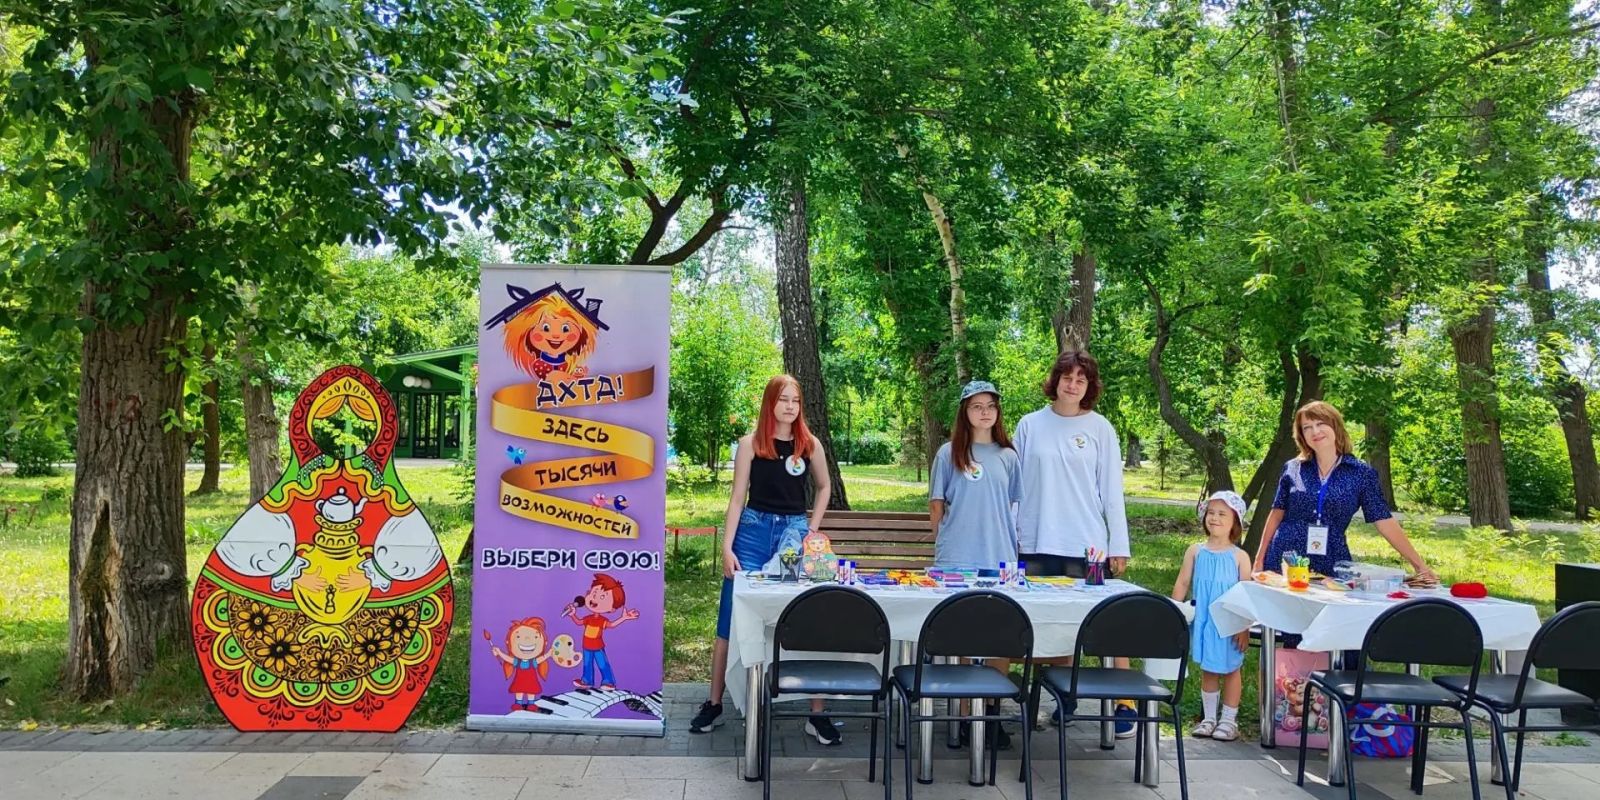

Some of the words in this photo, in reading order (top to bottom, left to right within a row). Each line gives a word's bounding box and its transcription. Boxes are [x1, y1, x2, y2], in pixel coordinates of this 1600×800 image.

[536, 375, 623, 407] ДХТД!
[542, 418, 609, 443] ЗДЕСЬ
[534, 460, 617, 486] ТЫСЯЧИ
[501, 494, 632, 536] ВОЗМОЖНОСТЕЙ
[482, 549, 576, 569] ВЫБЕРИ
[584, 551, 659, 570] СВОЮ!
